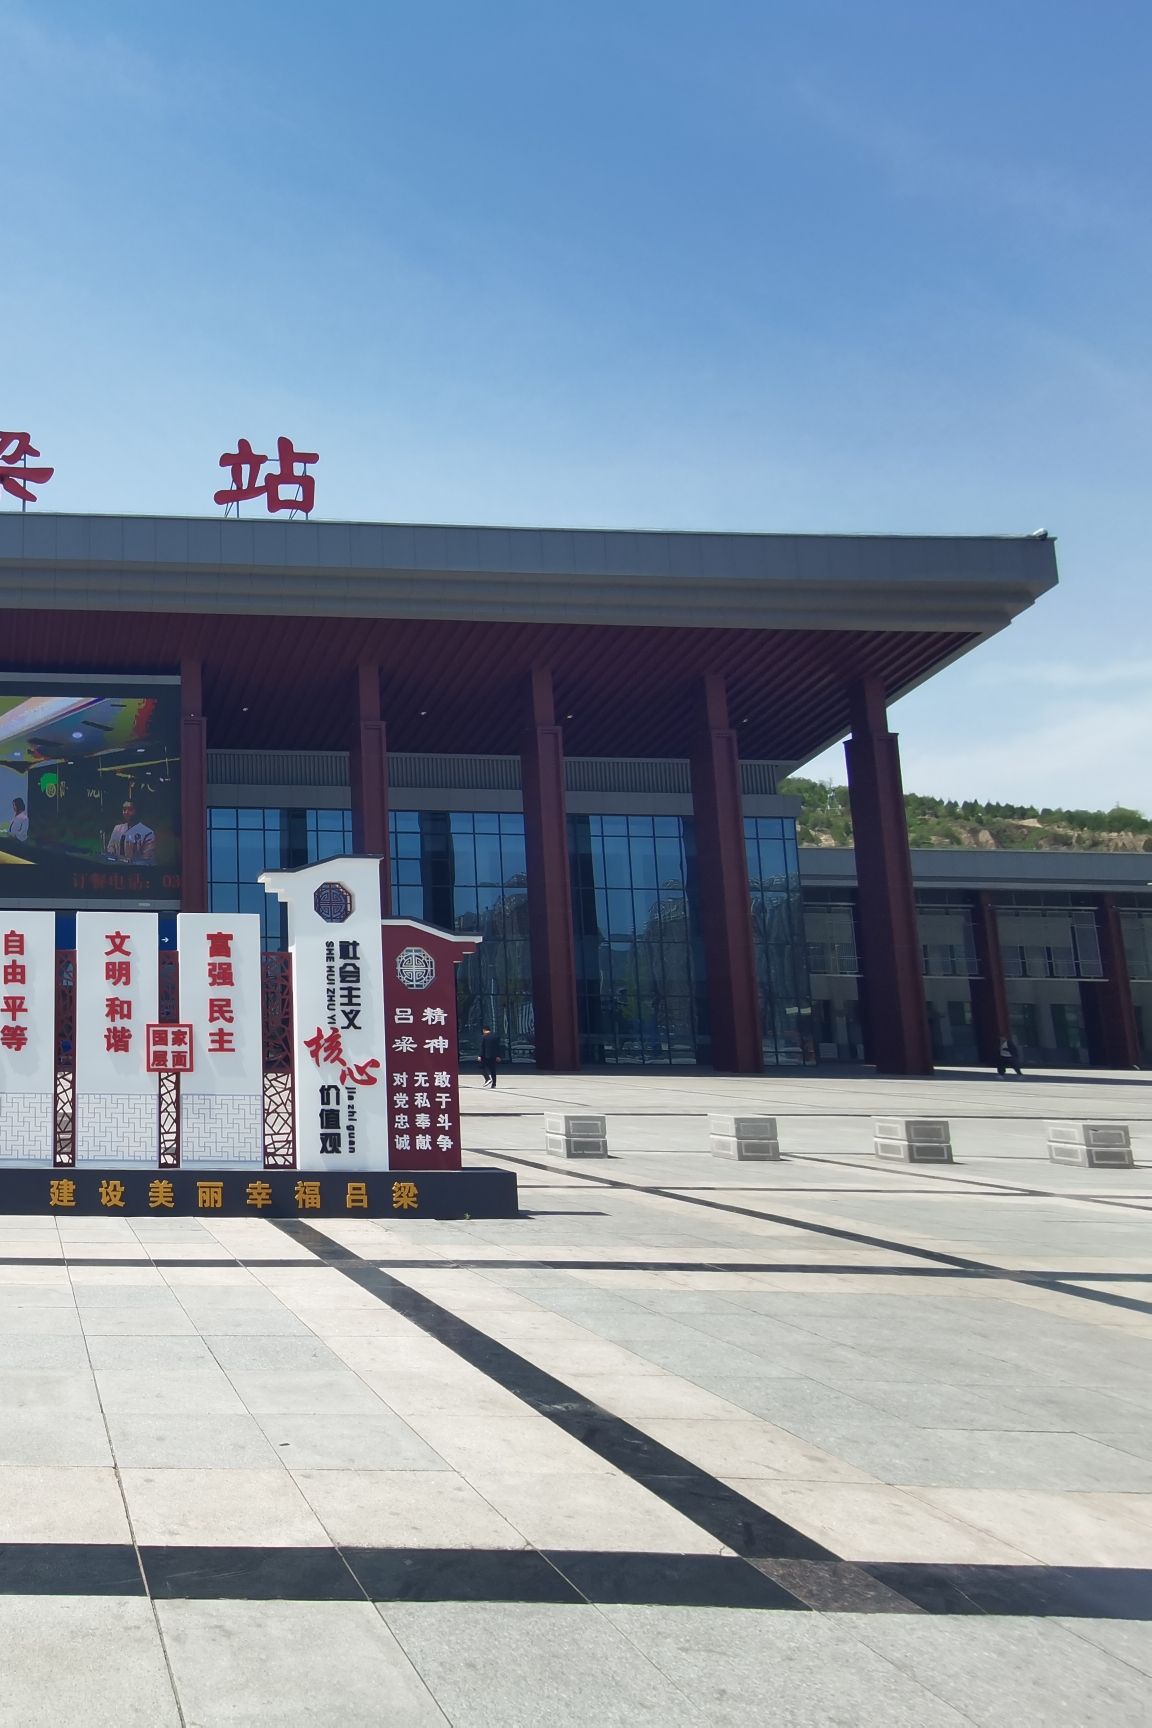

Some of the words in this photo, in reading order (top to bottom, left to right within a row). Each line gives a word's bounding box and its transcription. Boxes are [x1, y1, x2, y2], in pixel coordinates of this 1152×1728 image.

[325, 940, 335, 963] SHE
[326, 965, 336, 985] HUI
[0, 930, 28, 1052] 自由平等
[103, 930, 133, 1054] 文明和谐
[206, 931, 236, 1053] 富强民主
[326, 987, 336, 1011] ZHU
[338, 940, 362, 1030] 社会主义
[150, 1027, 189, 1047] 国家
[327, 1014, 337, 1025] YI
[391, 1007, 418, 1053] 吕梁
[420, 1007, 449, 1054] 精神
[150, 1050, 188, 1069] 层面
[303, 1026, 381, 1086] 核心
[319, 1084, 342, 1154] 价值观
[392, 1071, 411, 1151] 对党忠诚
[413, 1071, 432, 1151] 无私奉献
[433, 1071, 454, 1152] 敢于斗争
[49, 1178, 420, 1210] 建设美丽幸福吕梁
